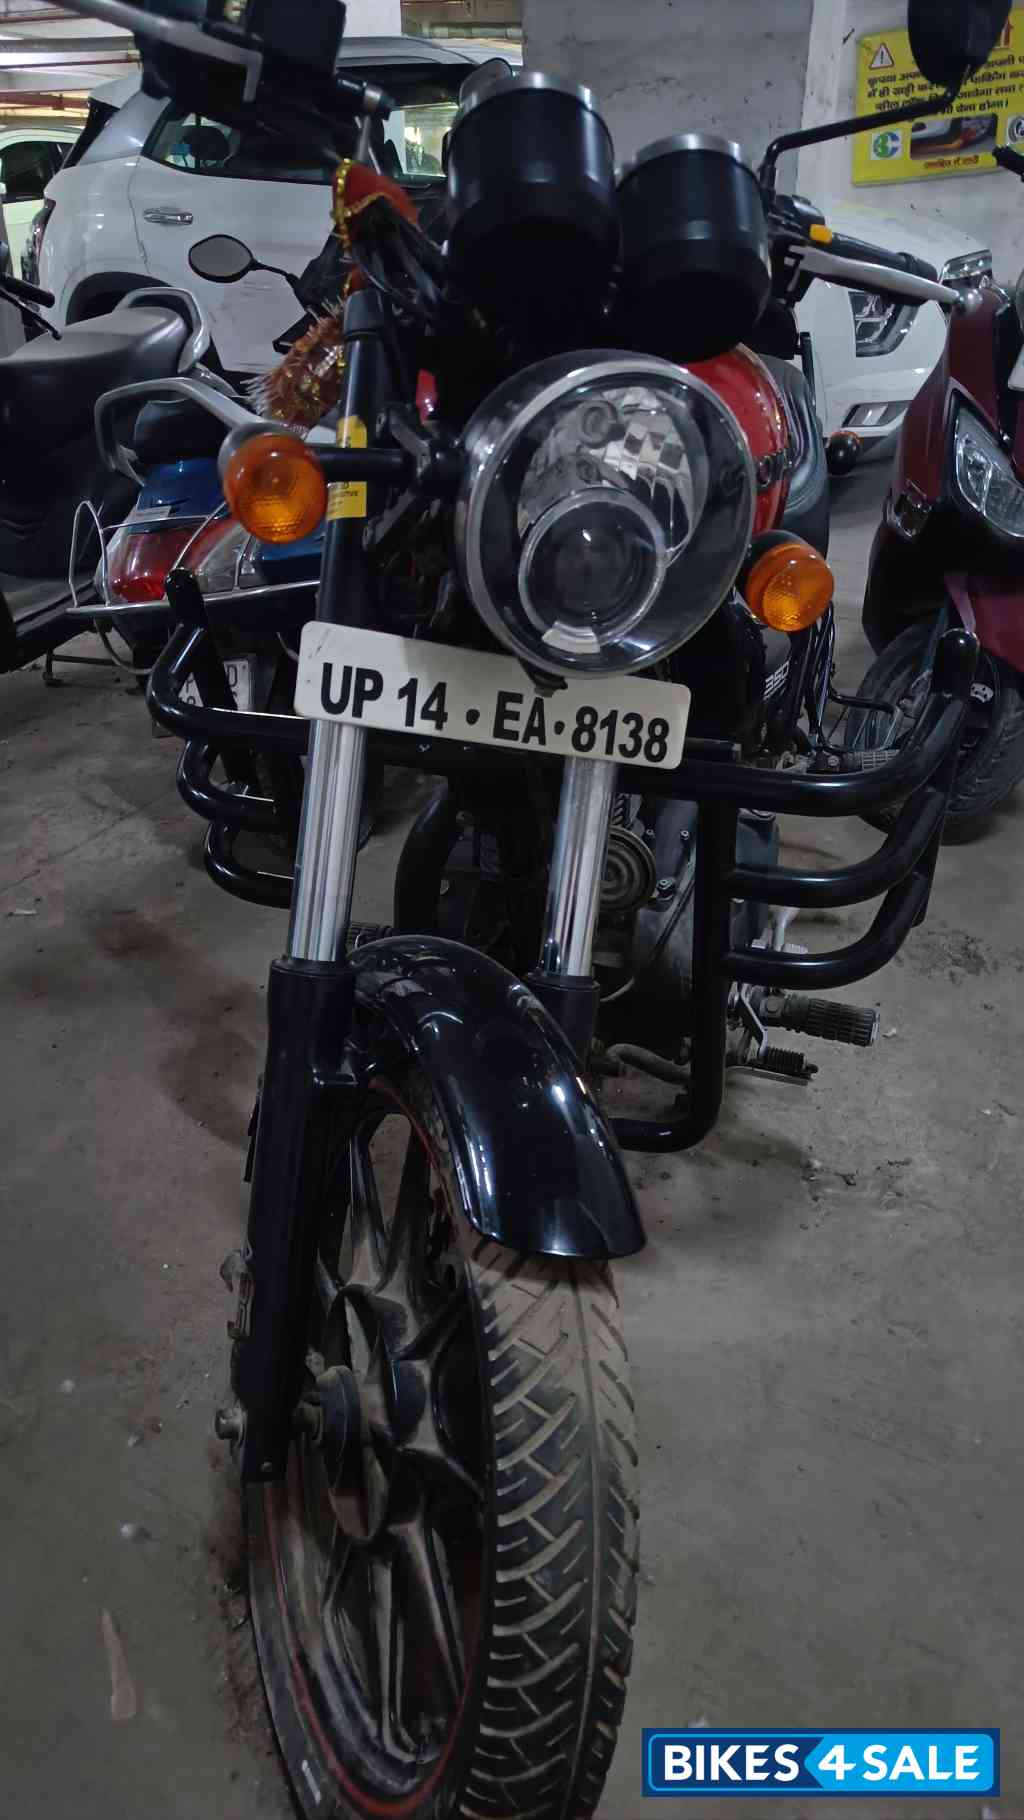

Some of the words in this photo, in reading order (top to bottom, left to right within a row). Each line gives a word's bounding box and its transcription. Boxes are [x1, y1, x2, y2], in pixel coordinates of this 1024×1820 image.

[320, 662, 384, 719] UP
[397, 677, 449, 731] 14
[571, 705, 670, 763] 8138
